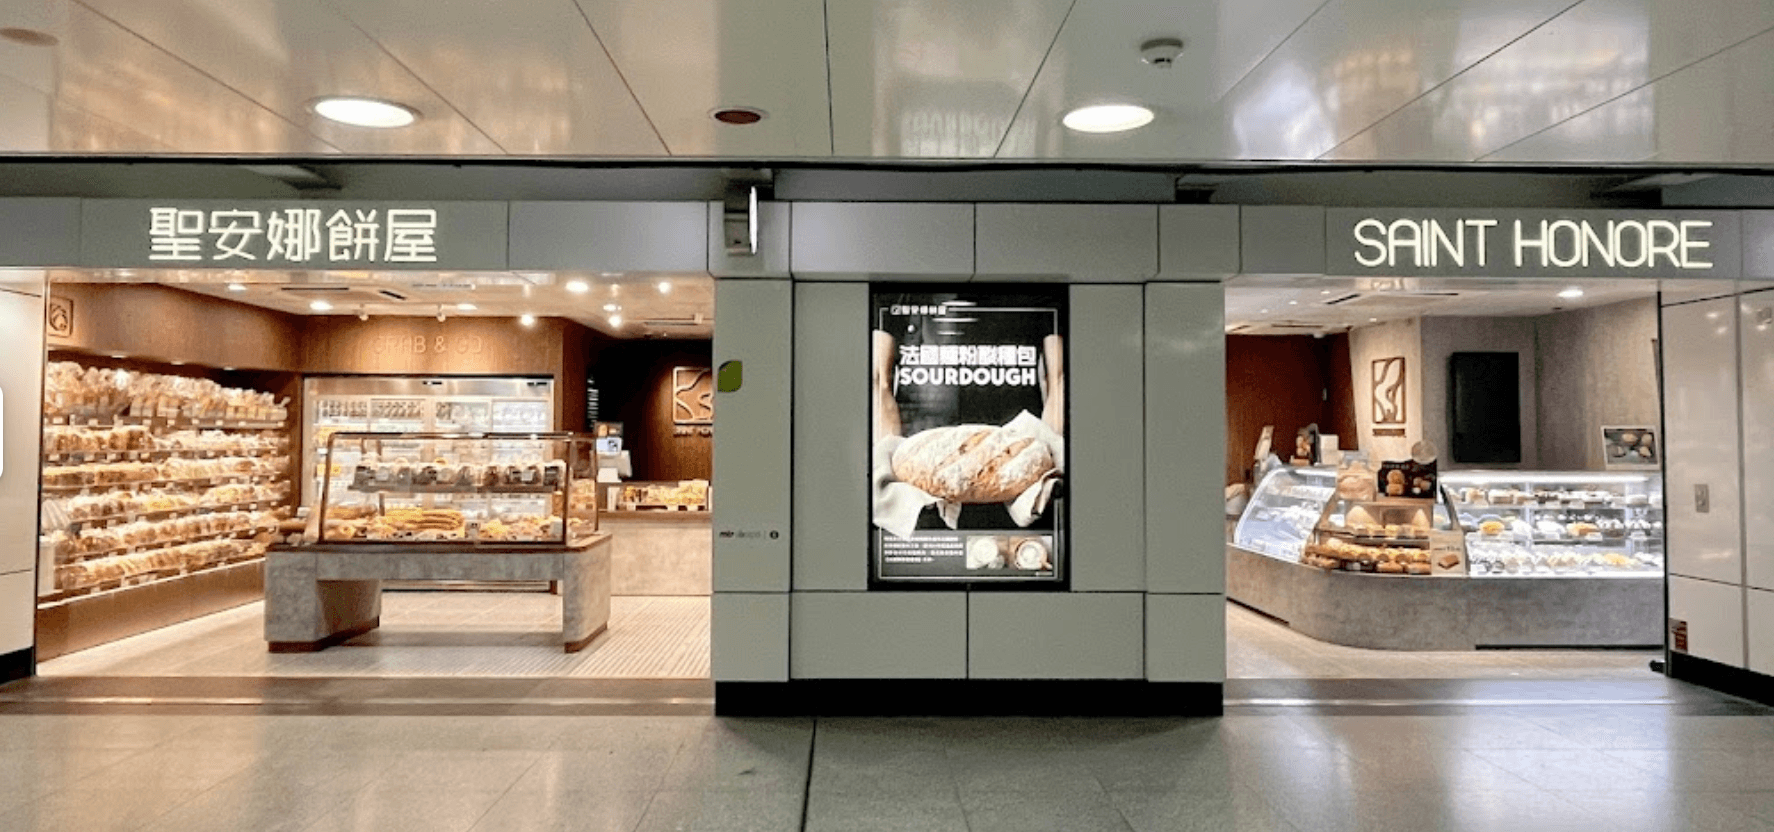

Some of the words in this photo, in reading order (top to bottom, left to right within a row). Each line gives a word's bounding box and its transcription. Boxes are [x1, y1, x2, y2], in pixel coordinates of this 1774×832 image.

[149, 207, 437, 262] 聖安娜餅屋
[1354, 219, 1498, 267] SAINT
[1514, 219, 1713, 268] HONORE
[434, 335, 446, 353] &
[899, 367, 1037, 386] SOURDOUGH
